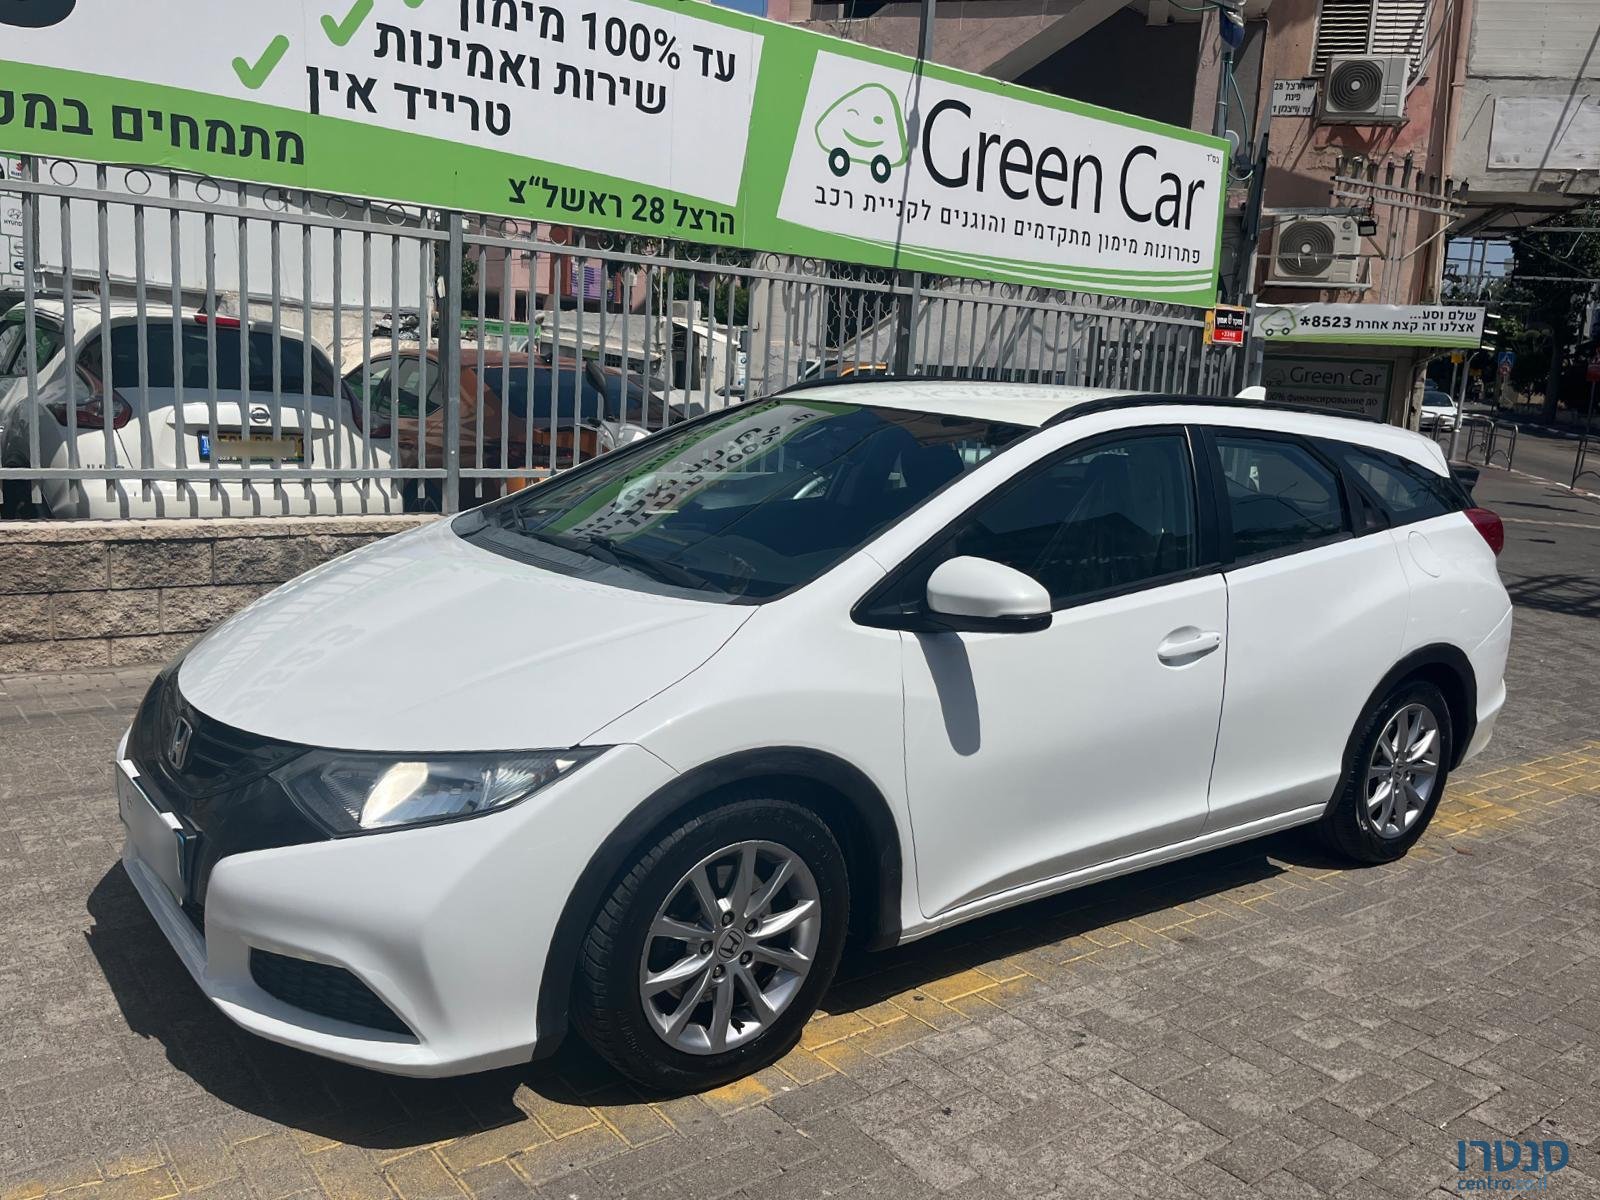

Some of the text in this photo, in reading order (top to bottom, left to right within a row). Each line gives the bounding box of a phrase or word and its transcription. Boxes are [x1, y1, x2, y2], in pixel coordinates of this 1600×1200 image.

[374, 23, 666, 114] שירות ואמינות
[461, 0, 735, 82] עד 100% מימון
[306, 66, 510, 135] טרייד אין
[112, 105, 304, 165] מתמחים
[922, 99, 1205, 230] Green Car
[509, 176, 734, 234] הרצל 28 ראשל"צ
[815, 186, 1199, 263] פתרונות מימון מתקדמים והוגנים לקניית רכב
[1355, 320, 1474, 333] אצלנו זה קצת אחרת
[1448, 309, 1476, 321] שלם
[1290, 366, 1382, 386] Green Car
